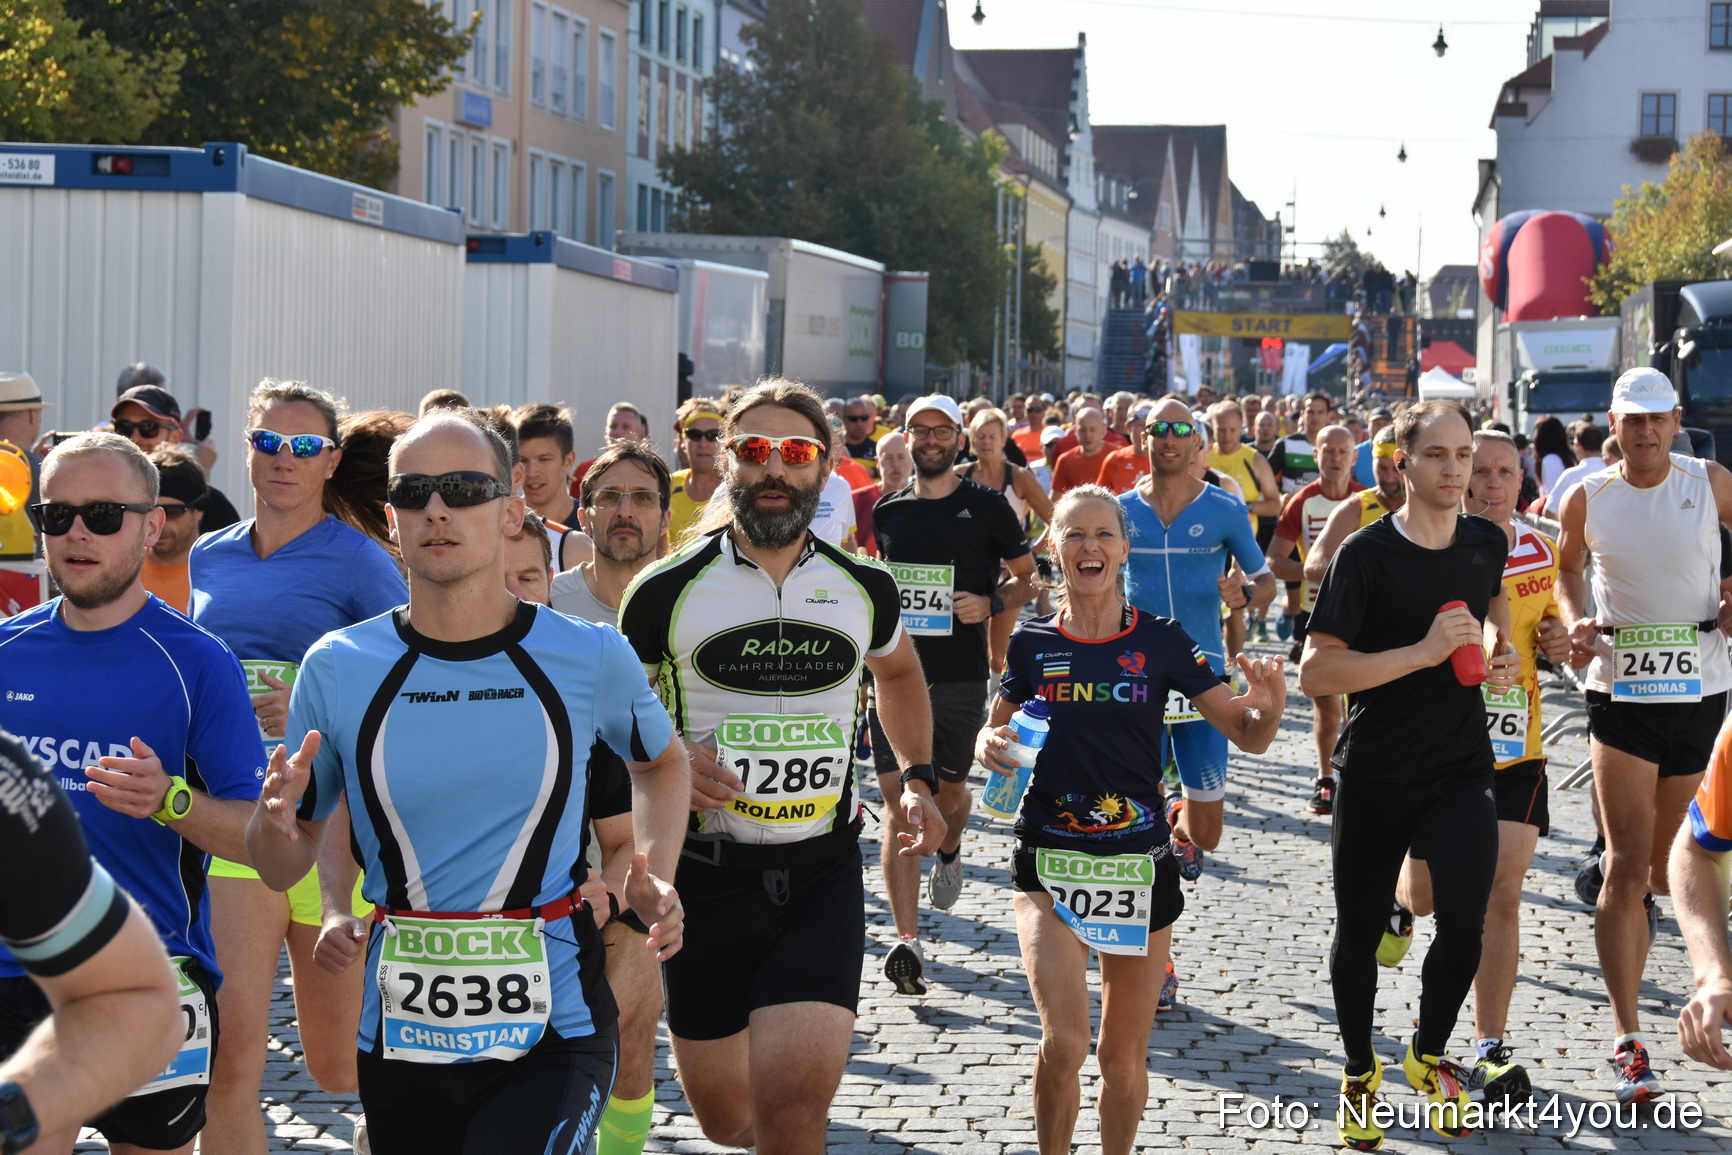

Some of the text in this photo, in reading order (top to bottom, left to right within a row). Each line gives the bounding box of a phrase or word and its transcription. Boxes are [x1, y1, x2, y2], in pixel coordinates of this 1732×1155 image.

[8, 158, 26, 170] 536
[1231, 317, 1294, 333] START
[889, 566, 946, 589] BOCK
[1515, 575, 1553, 598] BÖGL
[900, 616, 929, 627] RITZ
[1620, 626, 1694, 647] BOCK
[741, 638, 831, 657] RADAU
[719, 661, 845, 672] FAHRRADLADEN
[1623, 651, 1693, 676] 2476
[14, 693, 34, 701] JAKO
[497, 688, 525, 700] RACER
[1037, 682, 1148, 703] MENSCH
[1628, 682, 1687, 694] THOMAS
[724, 719, 837, 747] BOCK
[734, 757, 834, 794] 1286
[733, 800, 815, 819] ROLAND
[1045, 854, 1144, 882] BOCK
[395, 924, 532, 960] BOCK
[398, 972, 532, 1018] 2638
[400, 1026, 530, 1051] CHRISTIAN
